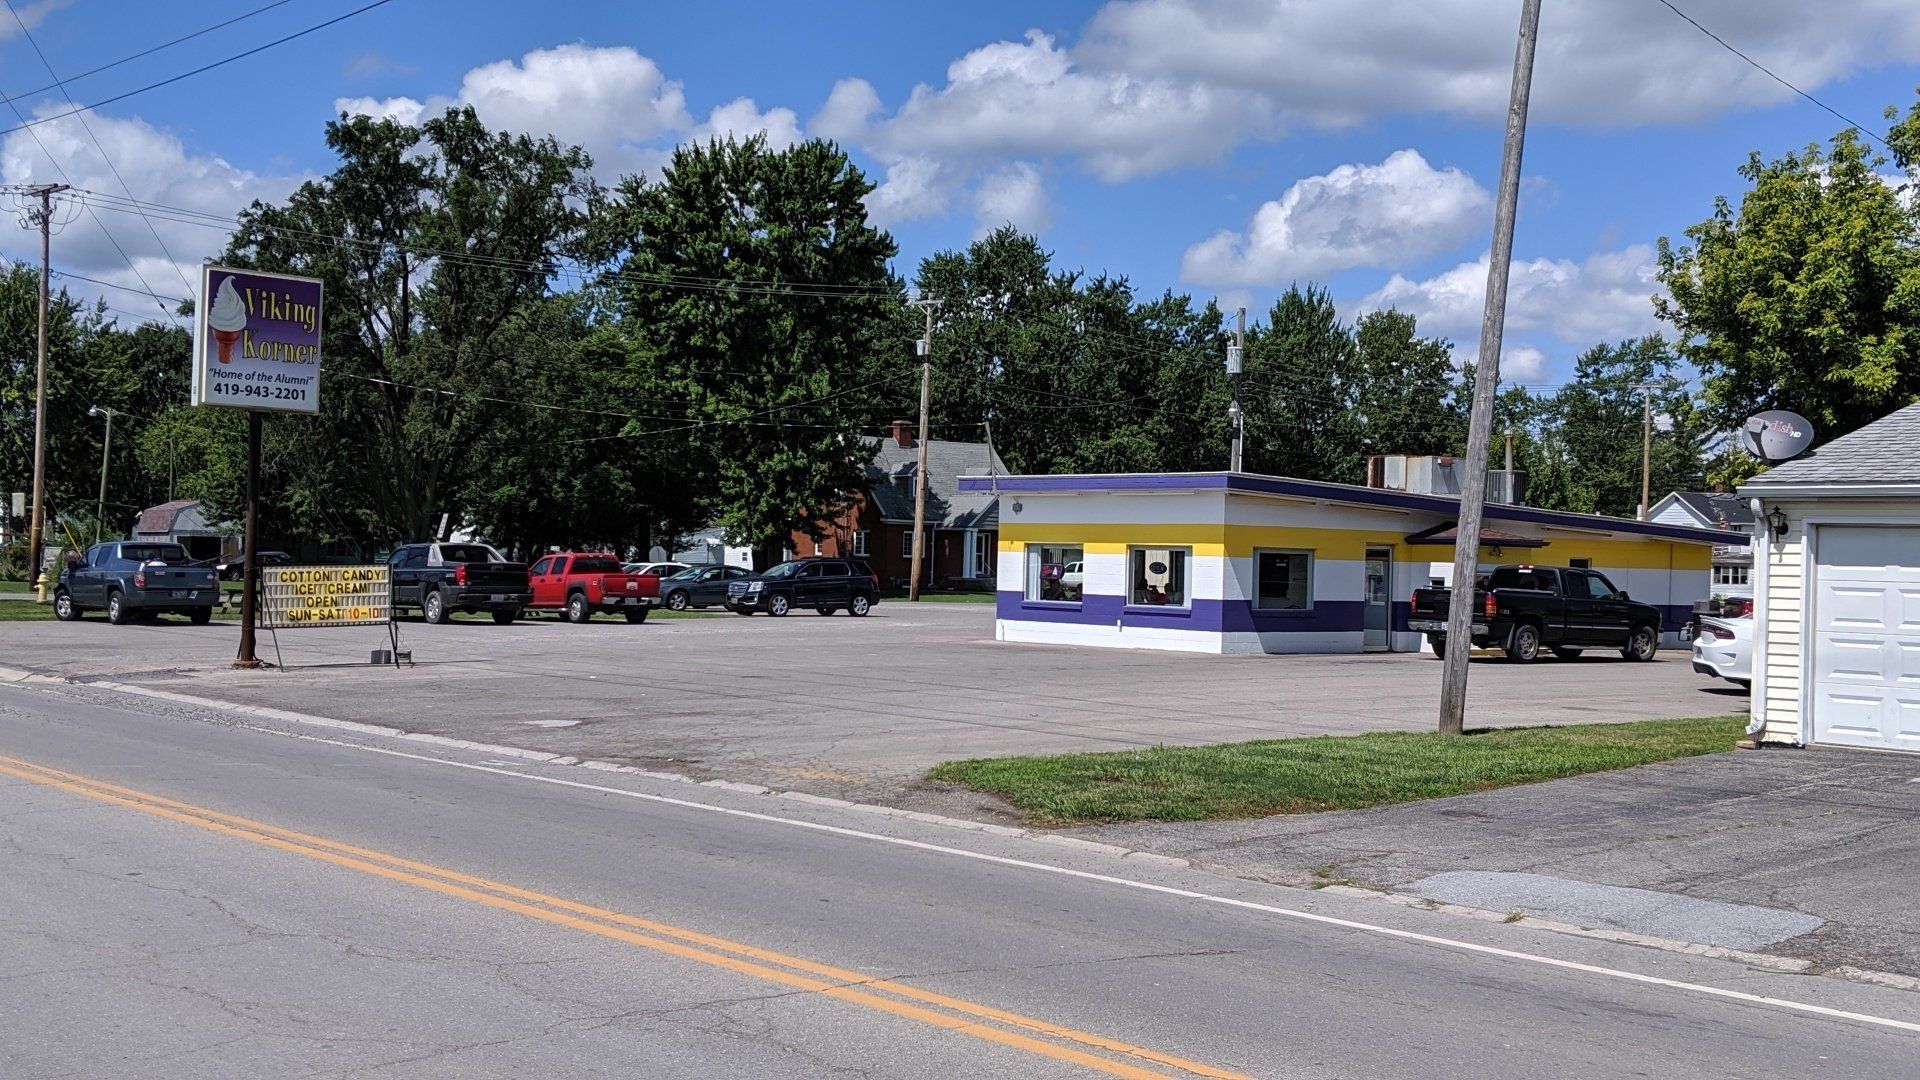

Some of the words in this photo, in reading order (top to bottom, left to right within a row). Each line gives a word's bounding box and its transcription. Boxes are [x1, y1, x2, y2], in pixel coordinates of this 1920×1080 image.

[245, 288, 316, 333] Viking
[242, 329, 317, 365] Korner
[244, 371, 257, 381] of
[257, 371, 273, 382] the
[213, 382, 306, 401] 419-943-2201
[1770, 420, 1794, 434] dish
[280, 571, 330, 582] COTTON
[342, 570, 381, 581] CANDY
[295, 584, 314, 595] ICE
[328, 583, 368, 594] CREAM
[306, 596, 338, 607] OPEN
[288, 608, 342, 621] SUN-SAT
[347, 607, 380, 619] 10-10
